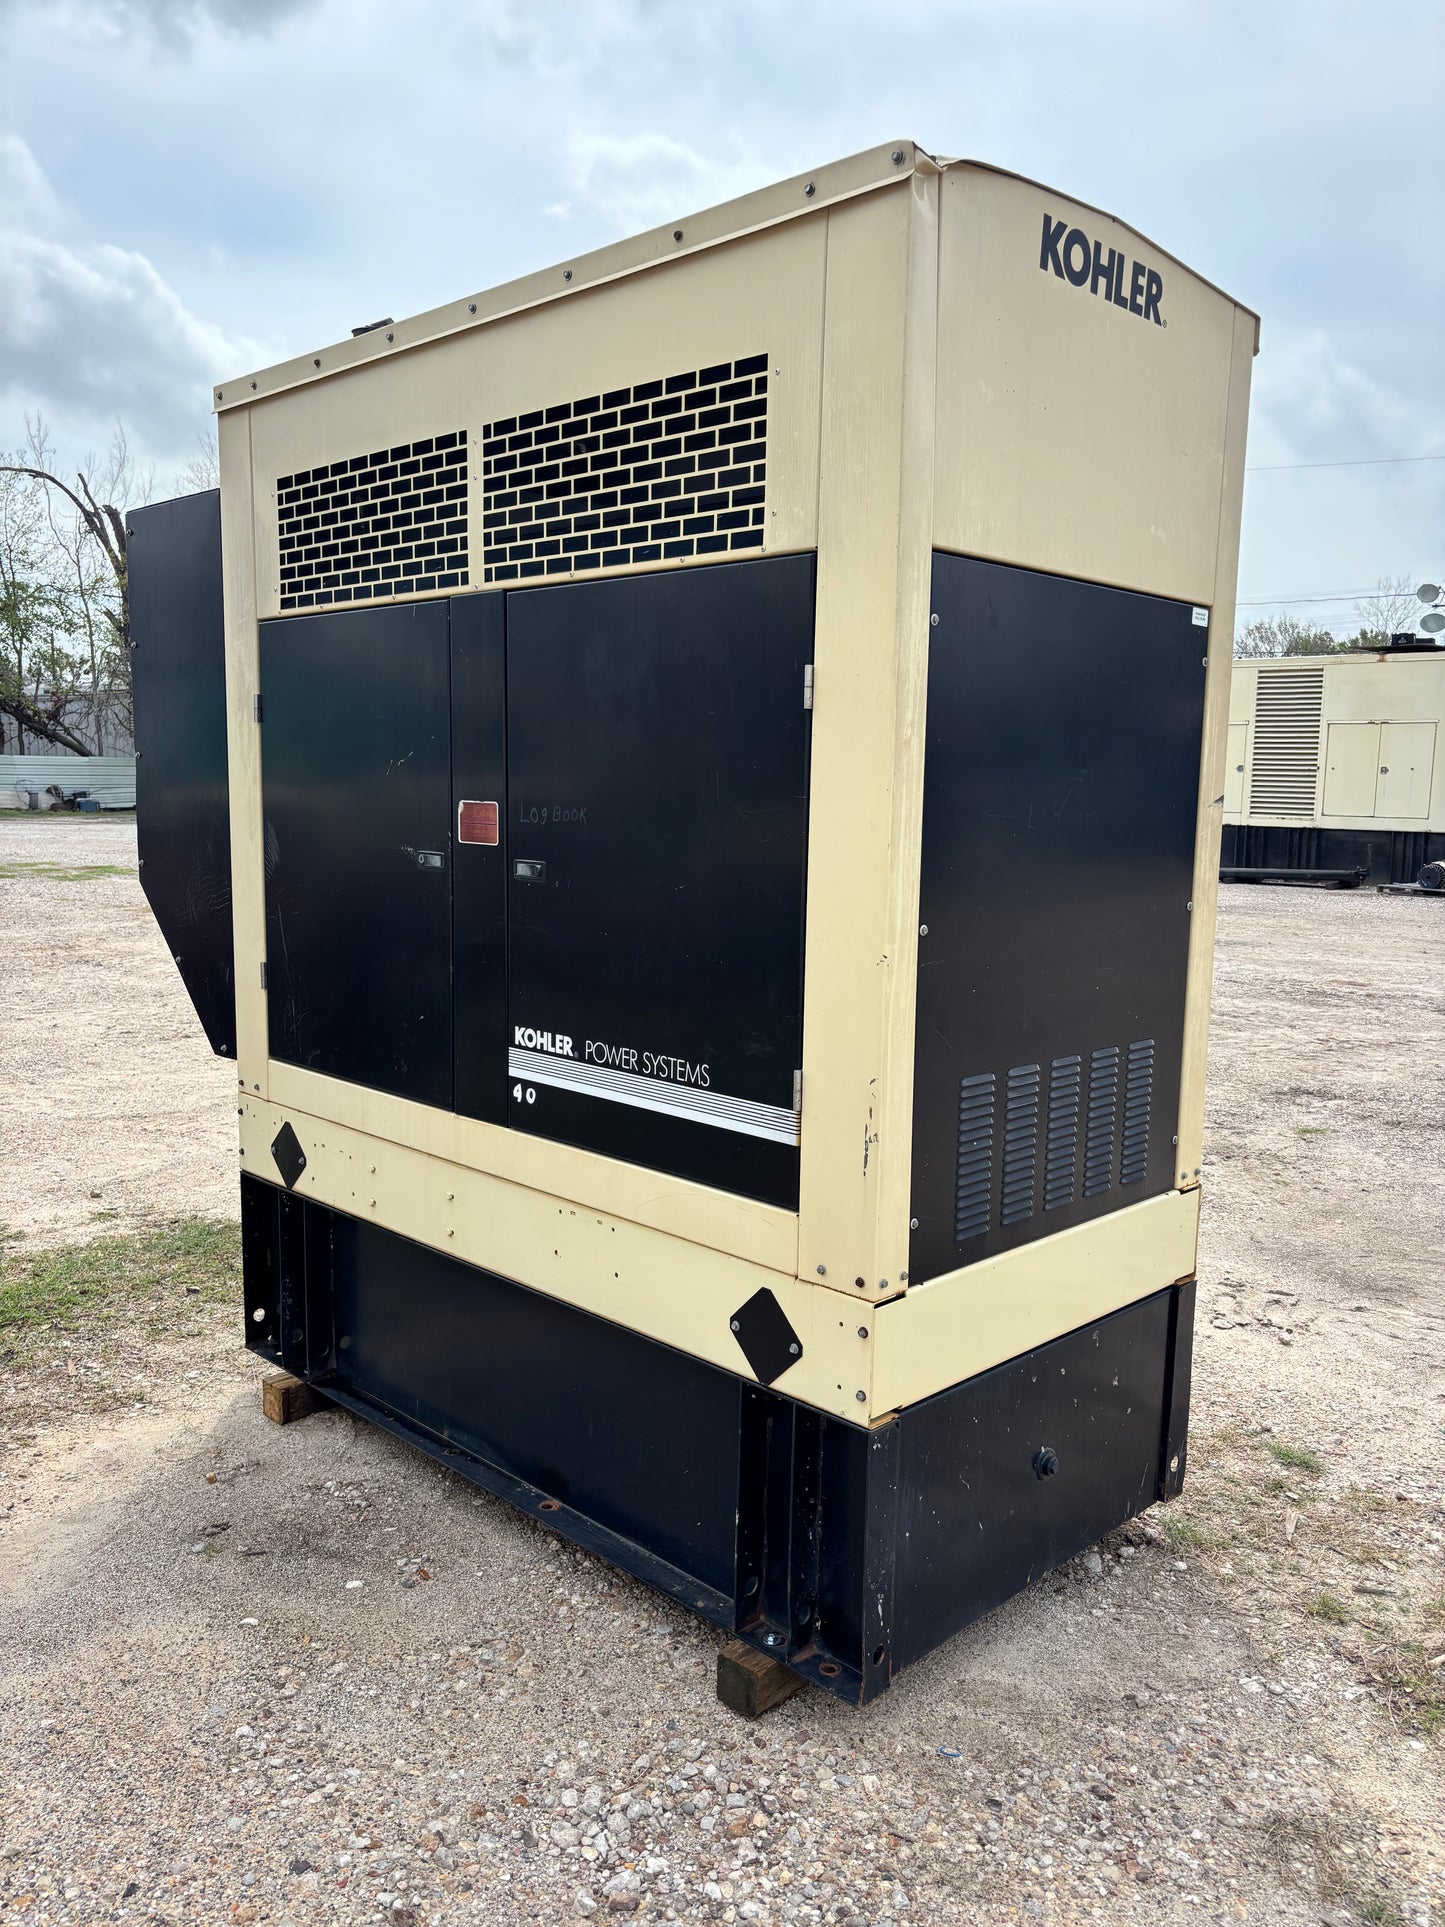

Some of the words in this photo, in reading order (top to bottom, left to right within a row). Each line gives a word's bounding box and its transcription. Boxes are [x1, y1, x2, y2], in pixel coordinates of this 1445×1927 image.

[1039, 212, 1163, 327] KOHLER
[514, 1025, 574, 1057] KOHLER
[585, 1040, 639, 1072] POWER
[642, 1051, 711, 1088] SYSTEMS
[512, 1082, 537, 1105] 40
